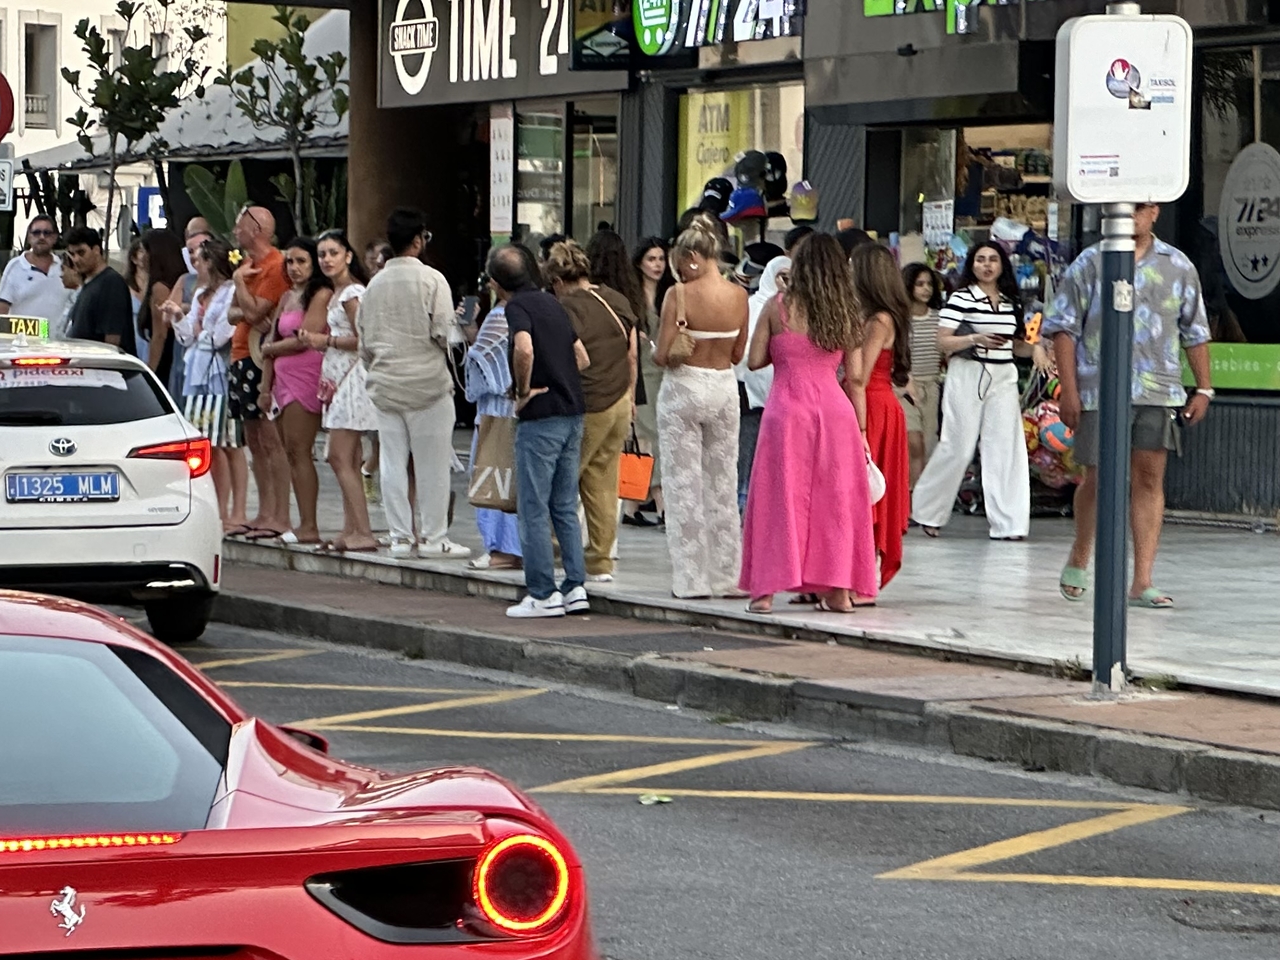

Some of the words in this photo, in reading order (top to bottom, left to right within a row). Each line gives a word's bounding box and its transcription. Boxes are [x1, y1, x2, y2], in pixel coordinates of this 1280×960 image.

[394, 24, 416, 50] SNACK
[416, 23, 434, 48] TIME
[448, 0, 517, 83] TIME
[9, 318, 40, 335] TAXI
[13, 367, 85, 378] pidetaxi
[22, 477, 64, 496] 1325
[78, 476, 112, 495] MLM
